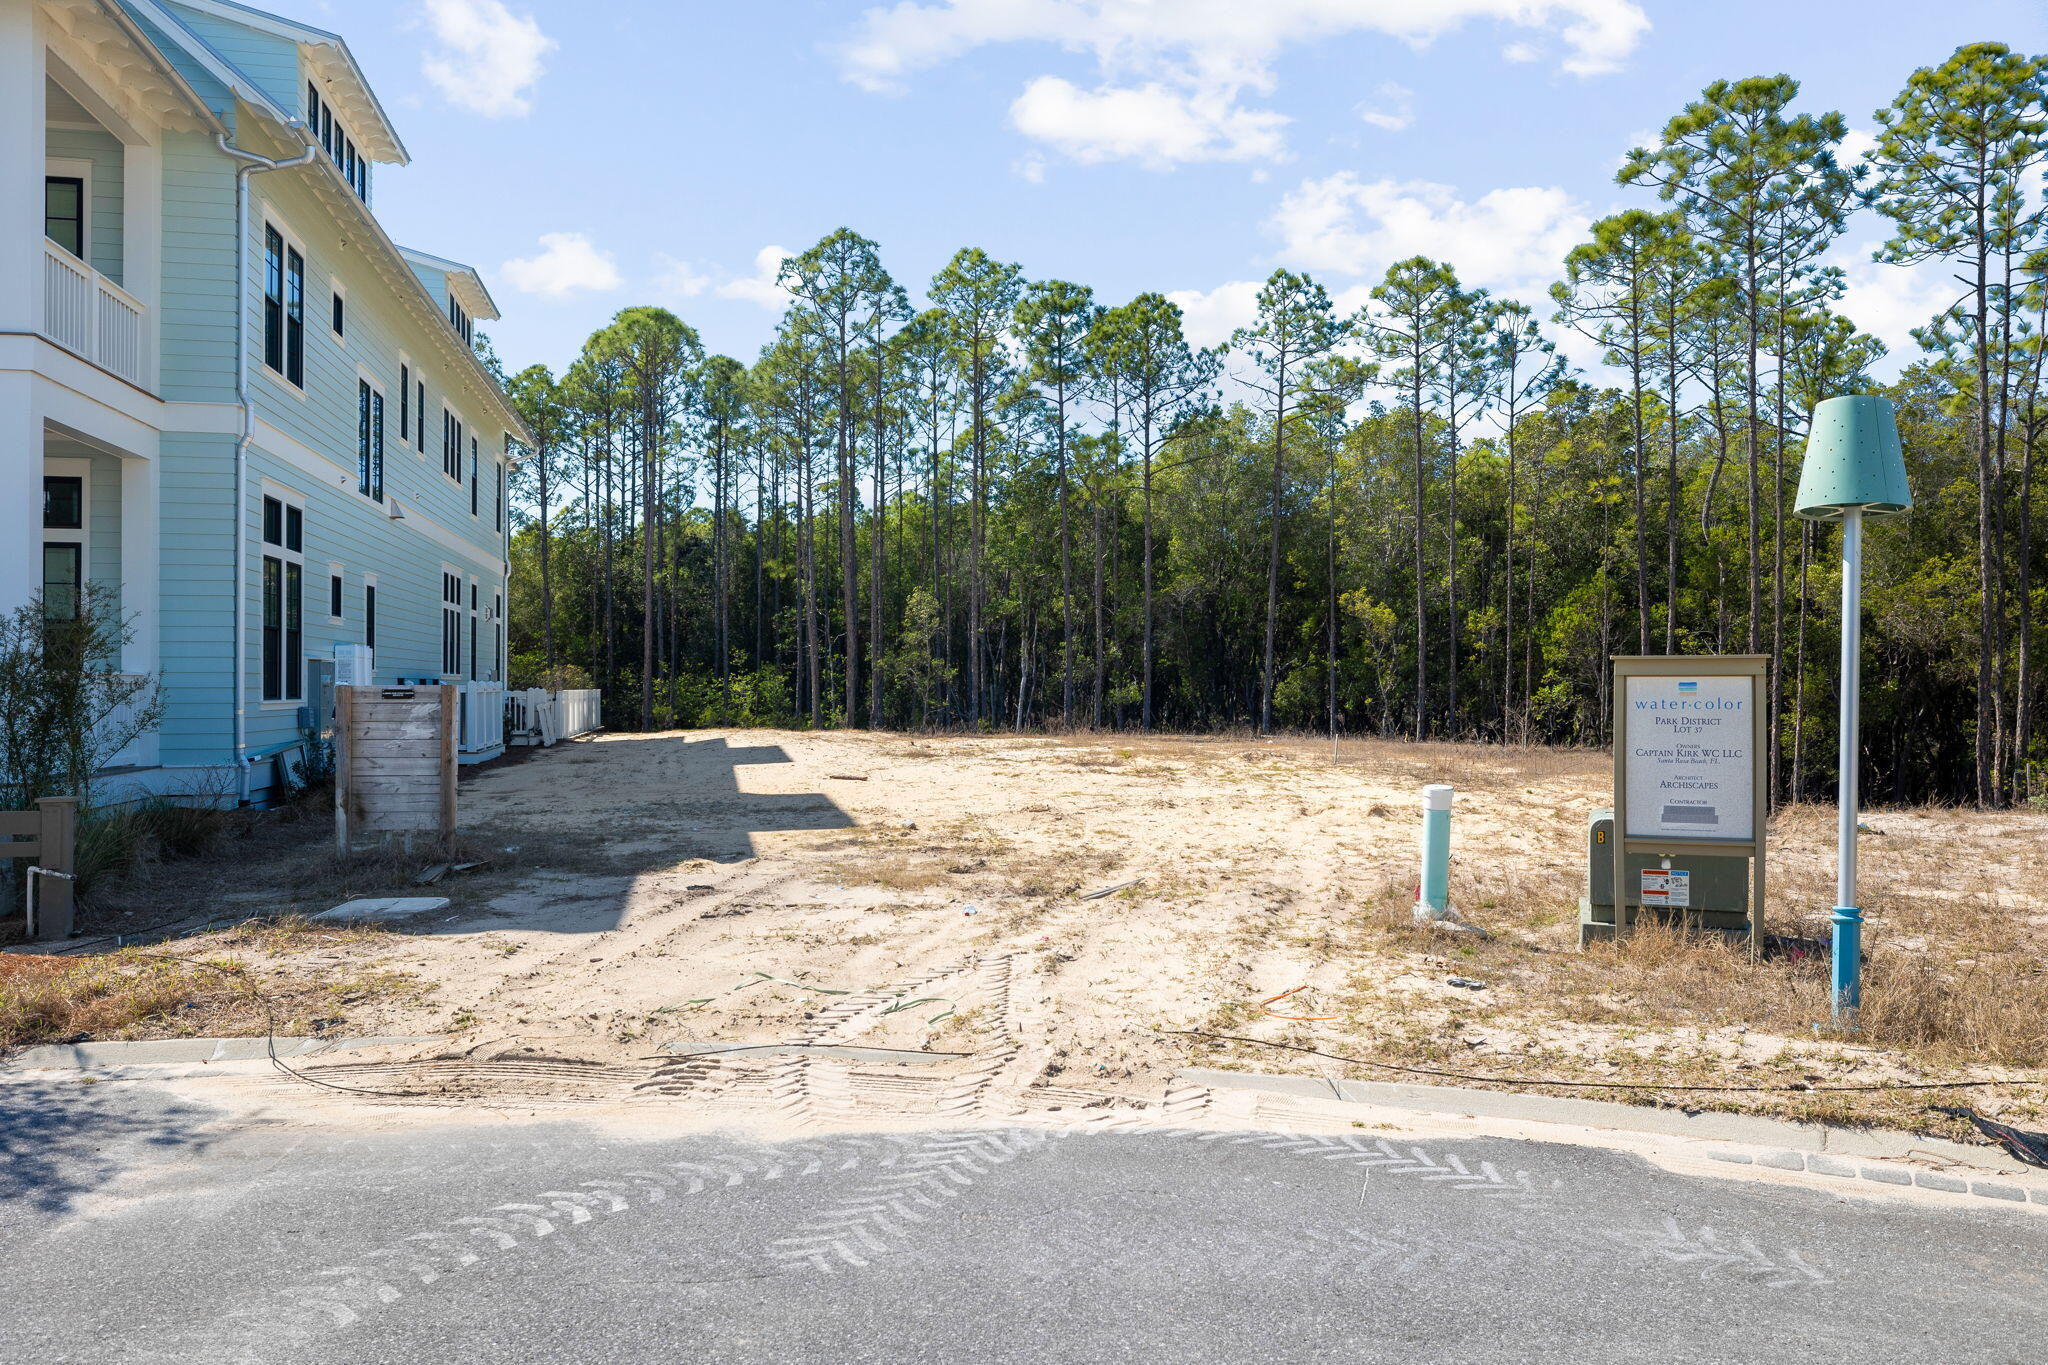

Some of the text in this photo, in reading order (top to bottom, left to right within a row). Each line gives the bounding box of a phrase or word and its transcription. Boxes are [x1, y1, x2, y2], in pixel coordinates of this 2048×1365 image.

[1655, 716, 1722, 726] PARK DISTRICT
[1674, 725, 1703, 735] LOT 37
[1635, 748, 1743, 759] CAPTAIN KIRK WC LLC
[1659, 780, 1719, 790] ARCHISCAPES
[1597, 831, 1604, 844] B
